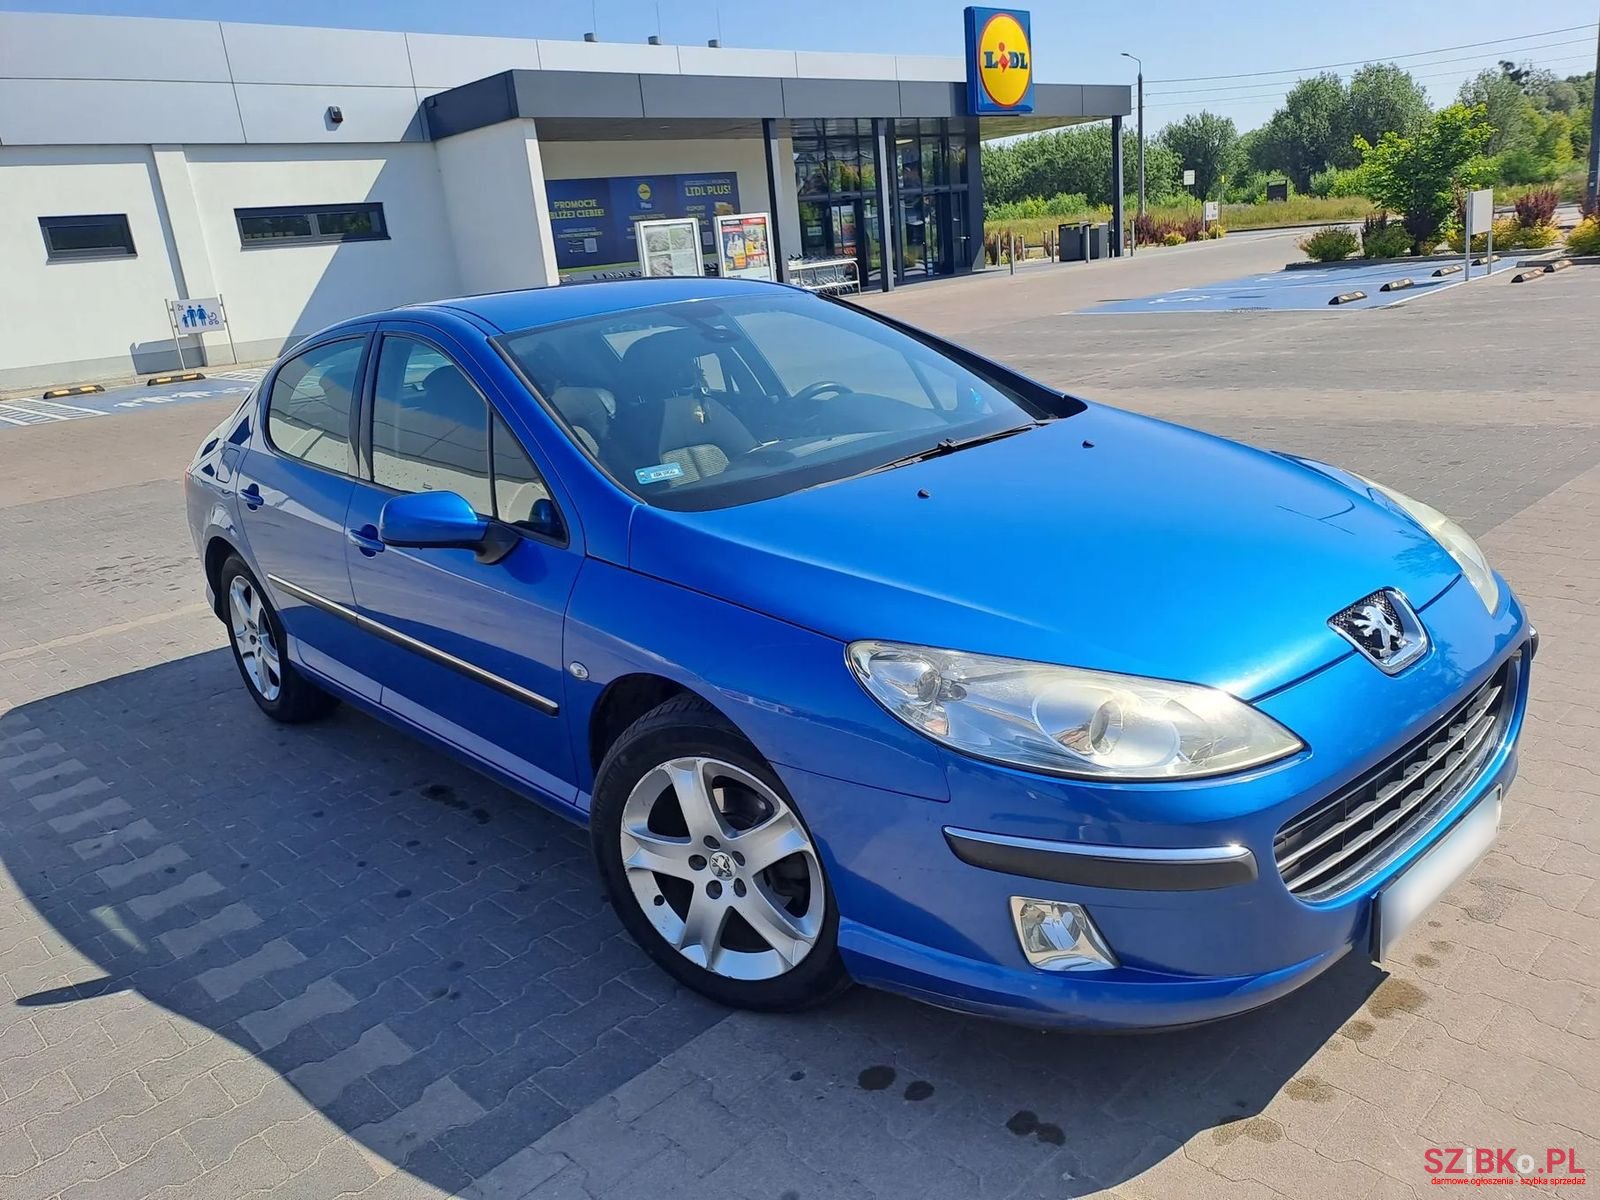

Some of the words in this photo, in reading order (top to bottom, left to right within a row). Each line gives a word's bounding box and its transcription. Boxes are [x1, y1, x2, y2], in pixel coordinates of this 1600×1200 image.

[685, 186, 706, 196] LIDL
[707, 185, 731, 195] PLUS!
[554, 199, 598, 209] PROMOCJE
